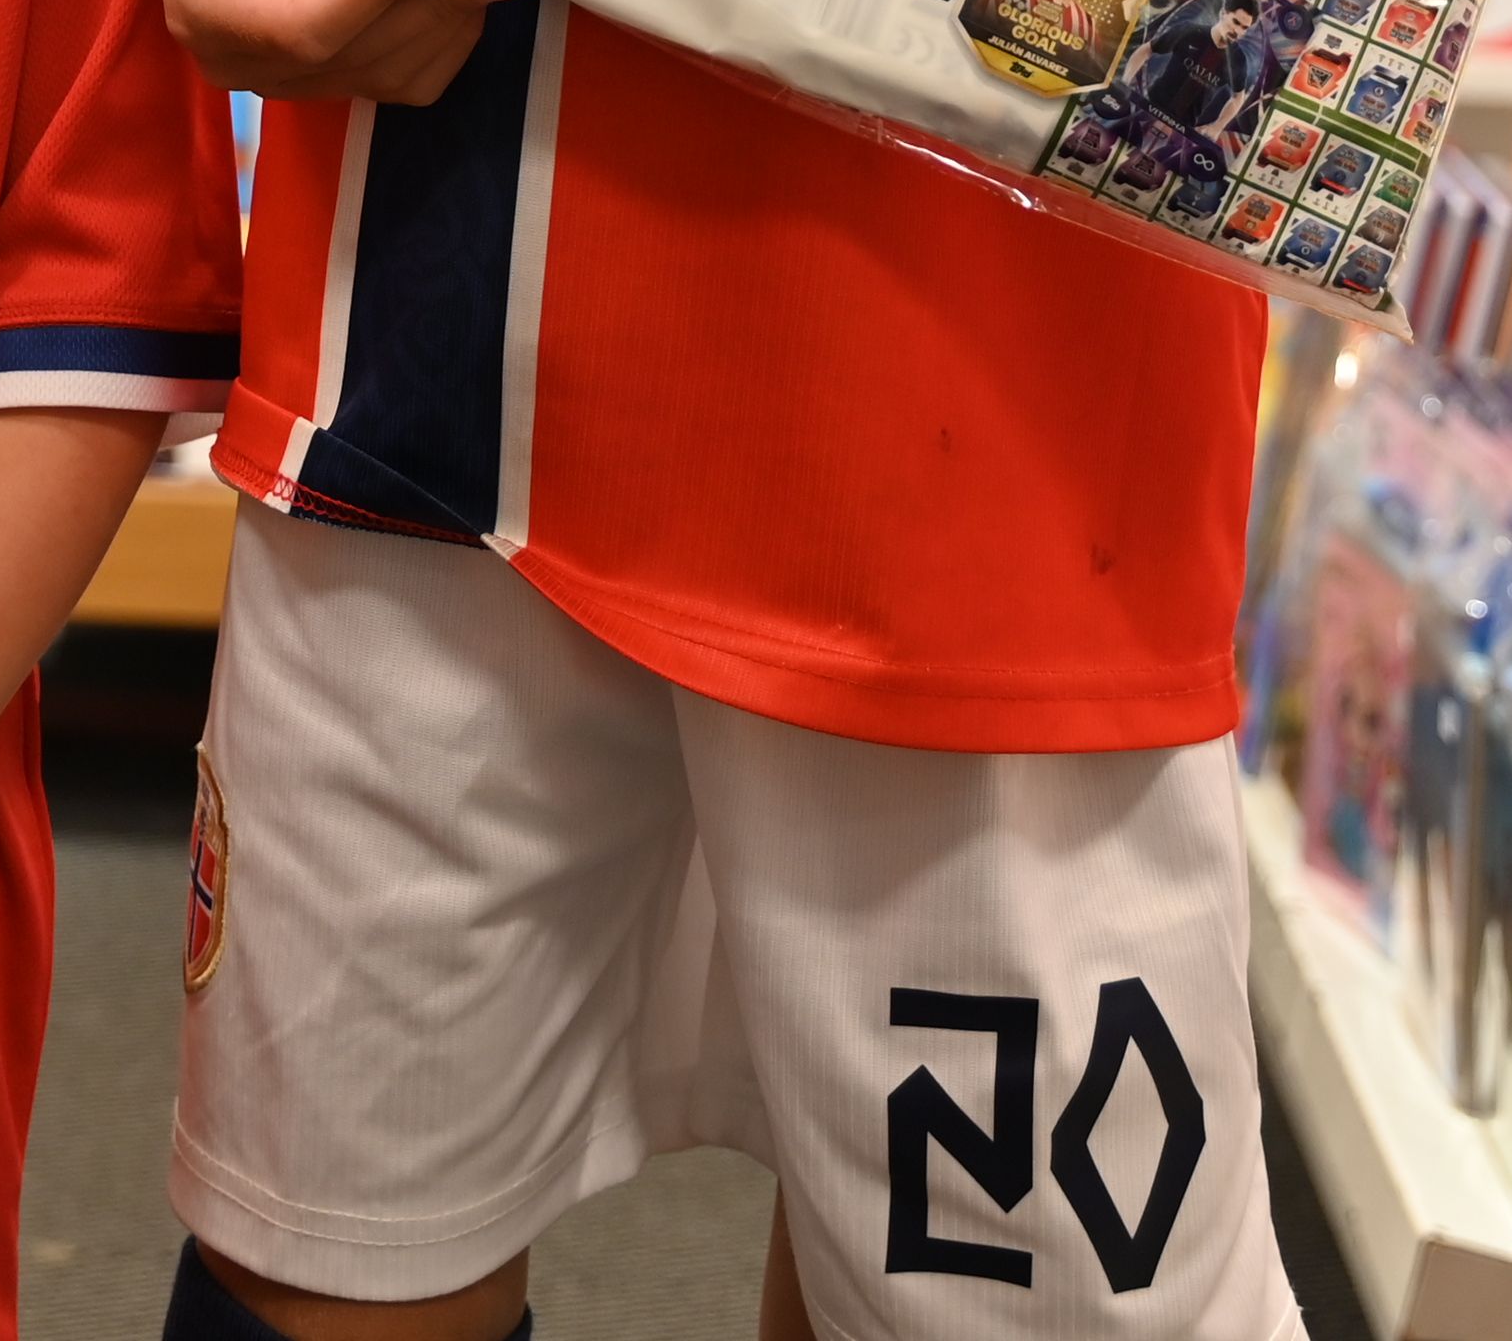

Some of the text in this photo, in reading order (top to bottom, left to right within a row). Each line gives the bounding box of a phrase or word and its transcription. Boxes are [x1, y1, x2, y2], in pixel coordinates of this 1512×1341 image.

[998, 1, 1086, 52] GLORIOUS
[1011, 24, 1058, 56] GOAL
[987, 34, 1070, 77] JULIÁN ALVAREZ
[1182, 56, 1222, 87] QATAR
[884, 975, 1207, 1296] 20
